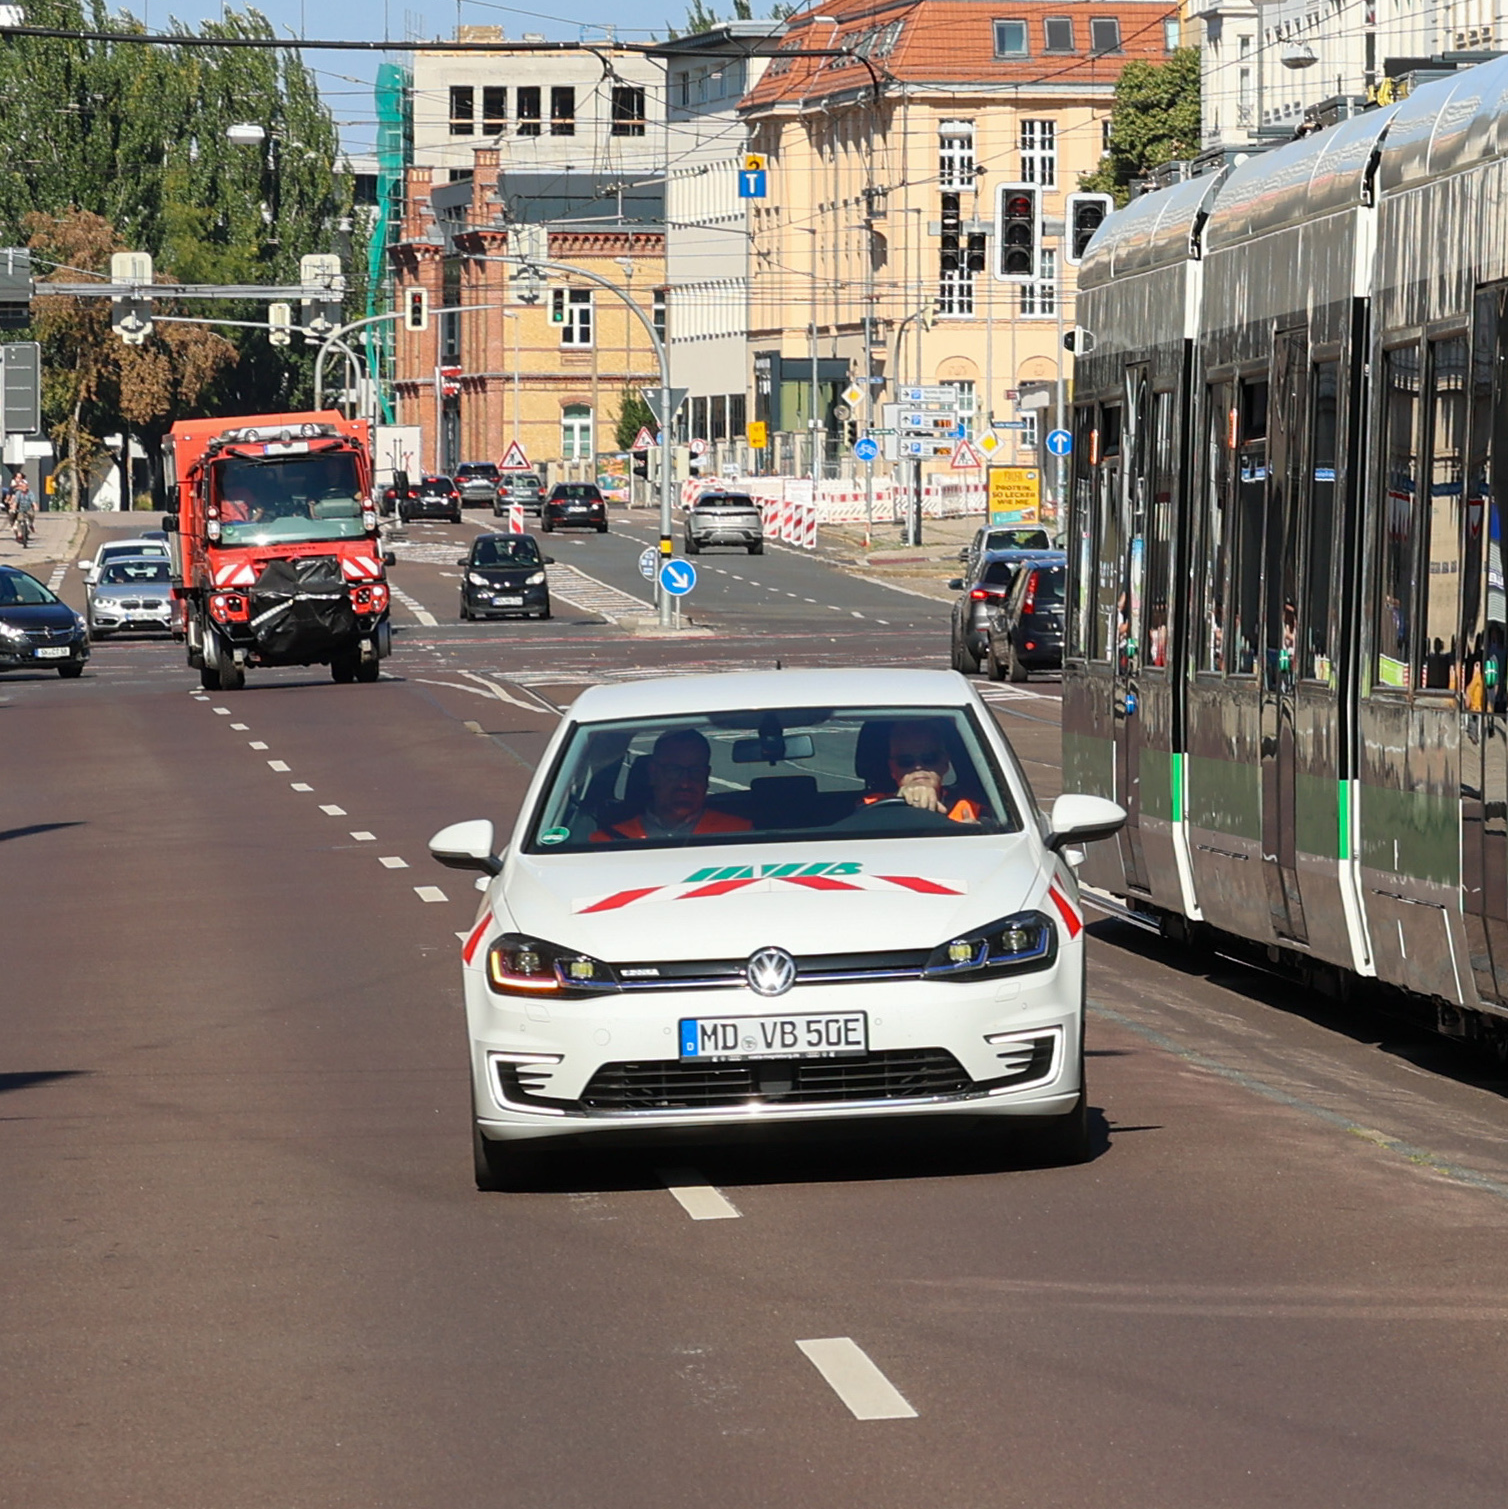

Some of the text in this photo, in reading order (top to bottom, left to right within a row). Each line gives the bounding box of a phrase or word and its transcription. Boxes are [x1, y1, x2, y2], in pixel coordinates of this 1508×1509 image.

[745, 174, 759, 194] T
[700, 1017, 862, 1052] MD VB 50E
